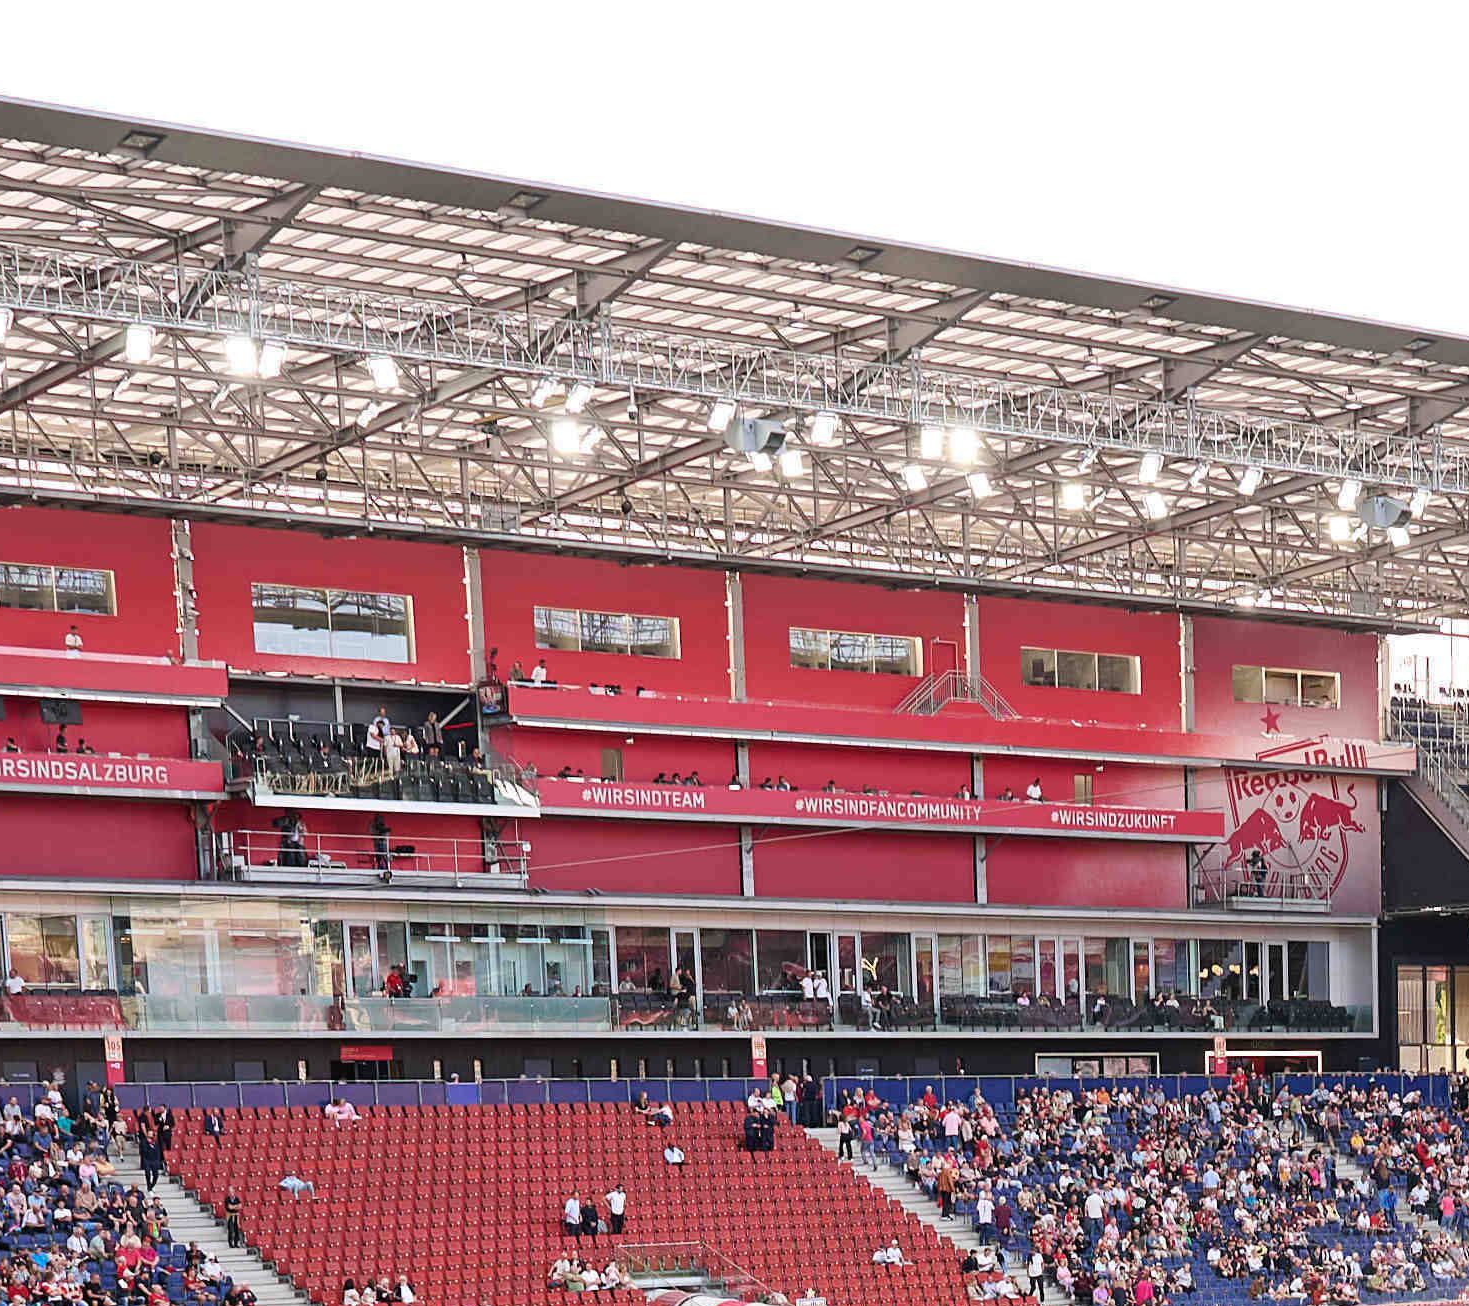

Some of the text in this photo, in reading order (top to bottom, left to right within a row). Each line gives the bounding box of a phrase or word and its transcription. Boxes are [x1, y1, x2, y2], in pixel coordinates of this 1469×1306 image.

[582, 787, 705, 809] #WIRSINDTEAM
[795, 798, 983, 821] #WIRSINDFANCOMMUNITY
[1050, 811, 1177, 830] #WIRSINDZUKUNFT
